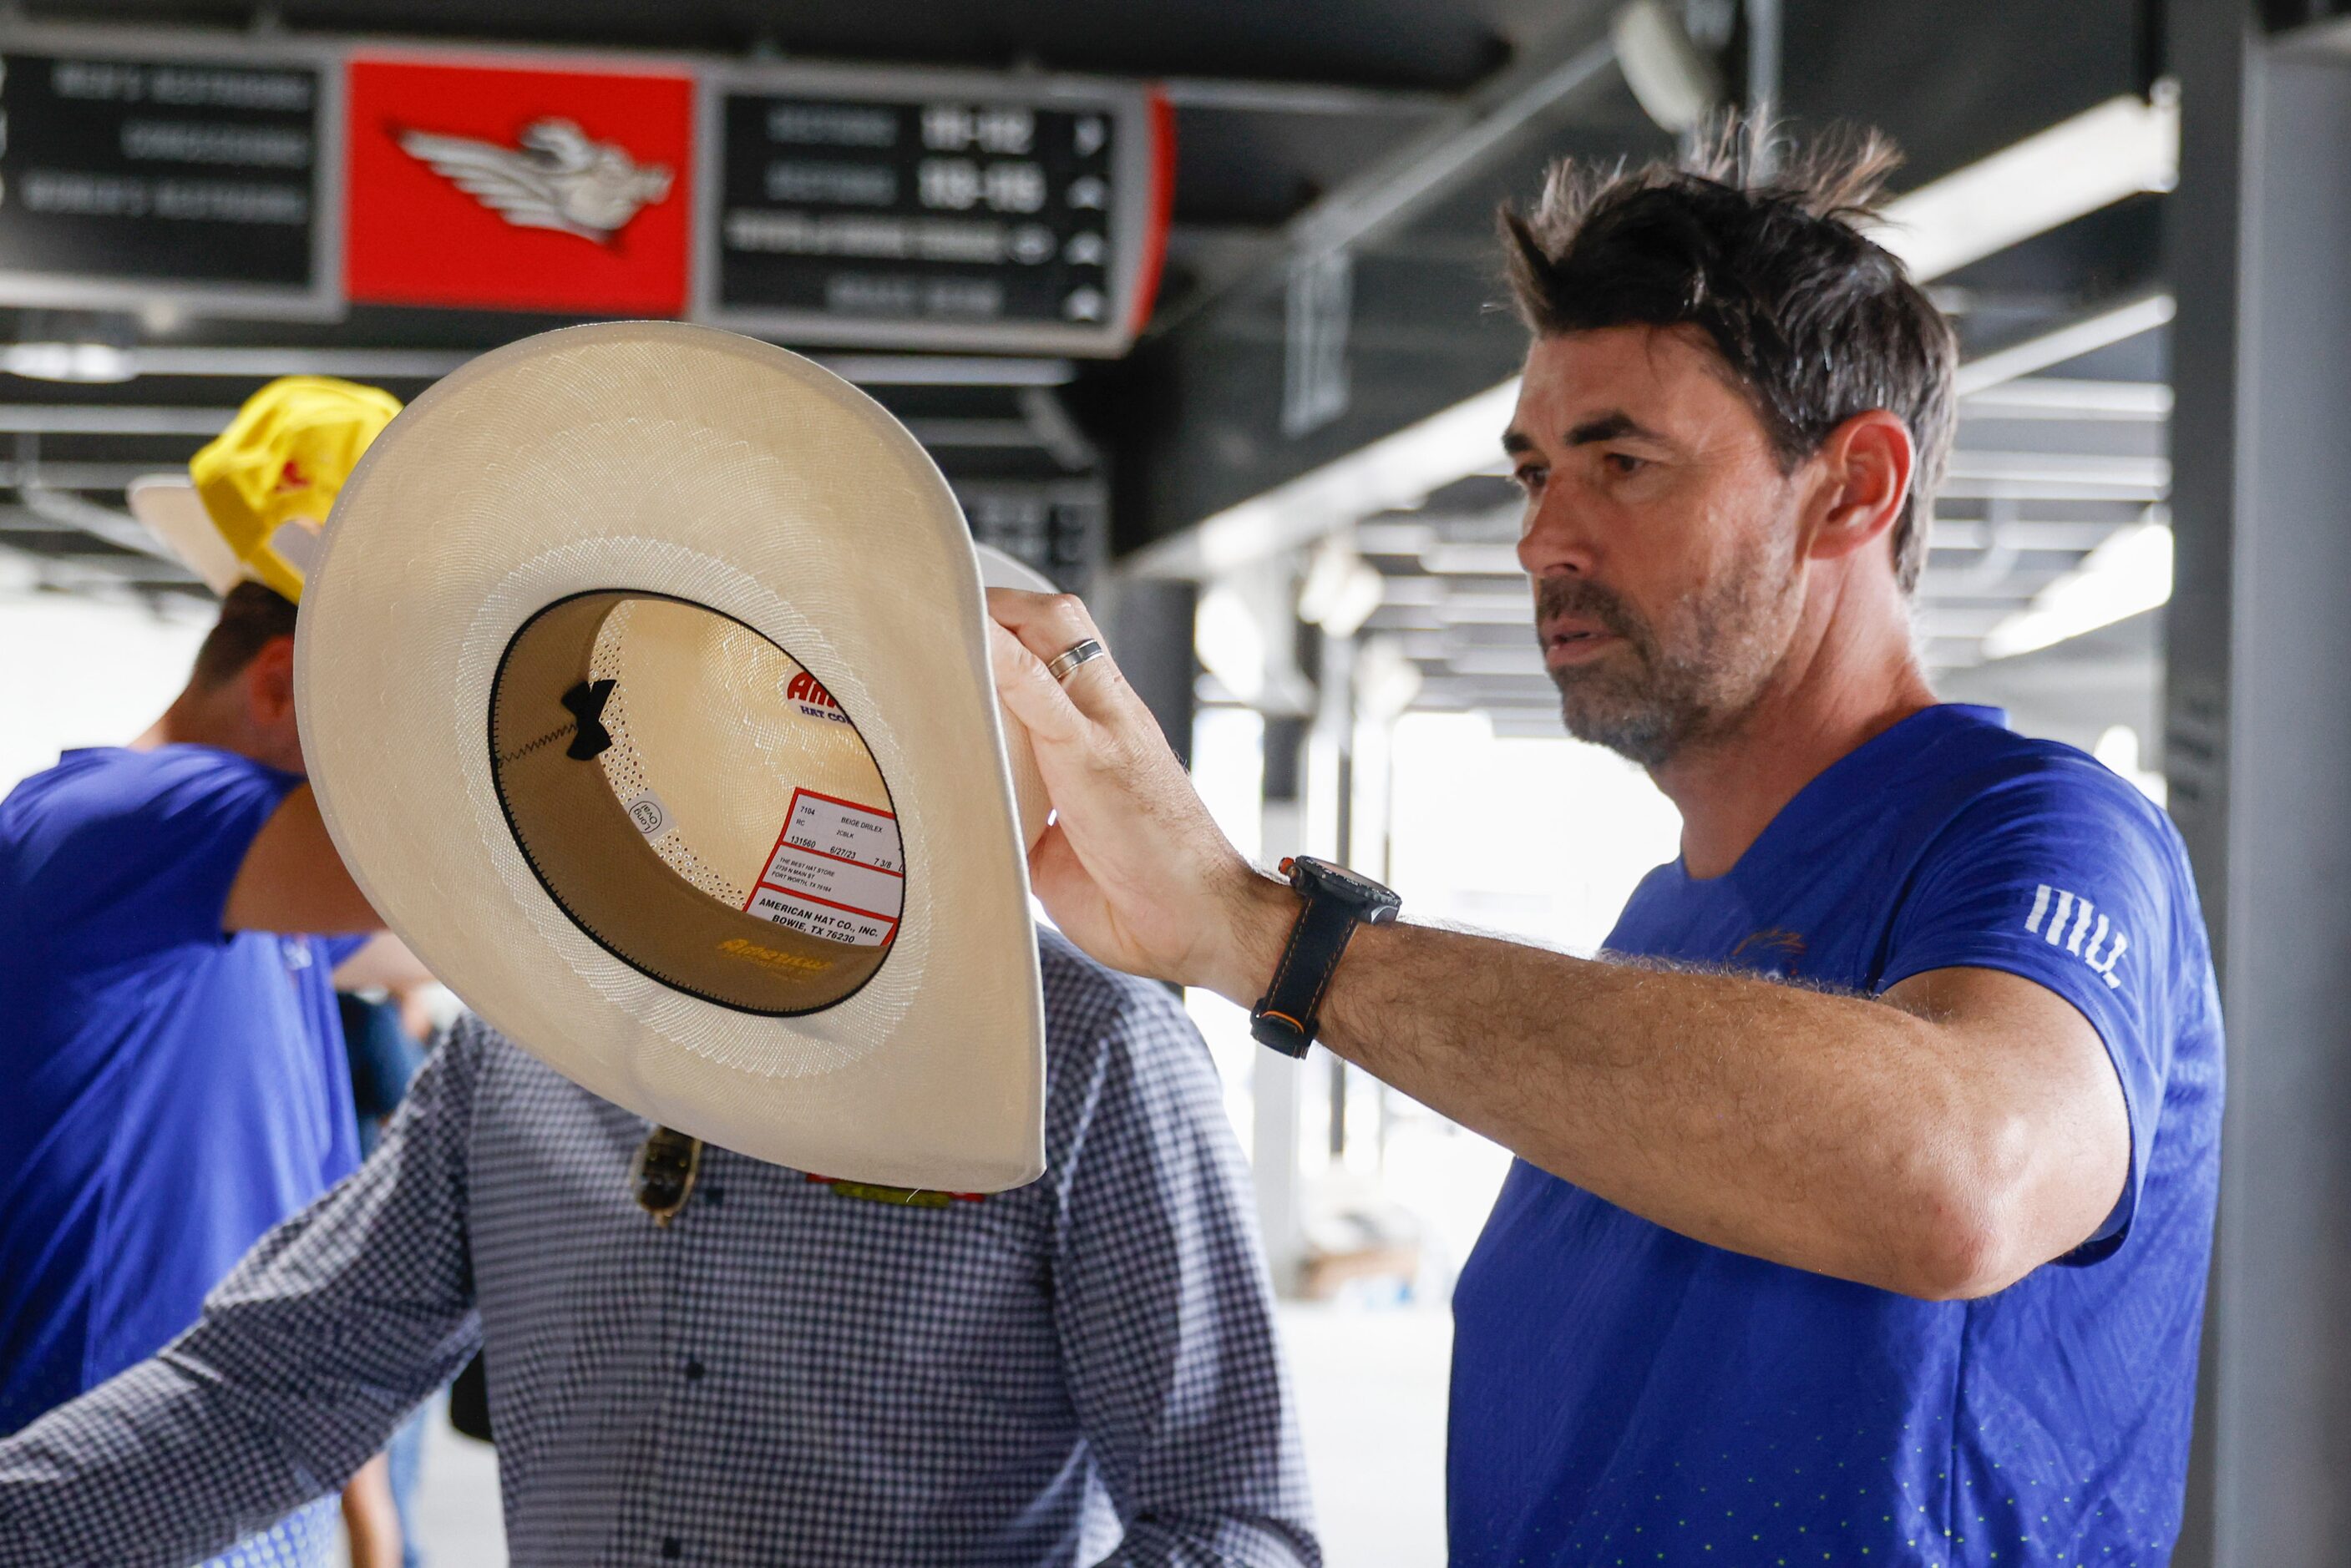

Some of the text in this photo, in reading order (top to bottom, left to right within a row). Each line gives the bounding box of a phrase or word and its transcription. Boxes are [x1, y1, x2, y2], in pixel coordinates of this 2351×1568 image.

[800, 705, 851, 724] HAT CO
[634, 808, 651, 831] Long
[641, 804, 657, 824] Oval
[800, 806, 884, 833] 7104 BEIGE DRILEX
[829, 846, 856, 859] 6/27/23
[880, 859, 892, 868] 3/8
[772, 871, 787, 879] FORT
[817, 867, 835, 878] STORE
[758, 898, 879, 938] AMERICAN HAT CO., INC.
[772, 914, 855, 943] BOWIE, TX 76230
